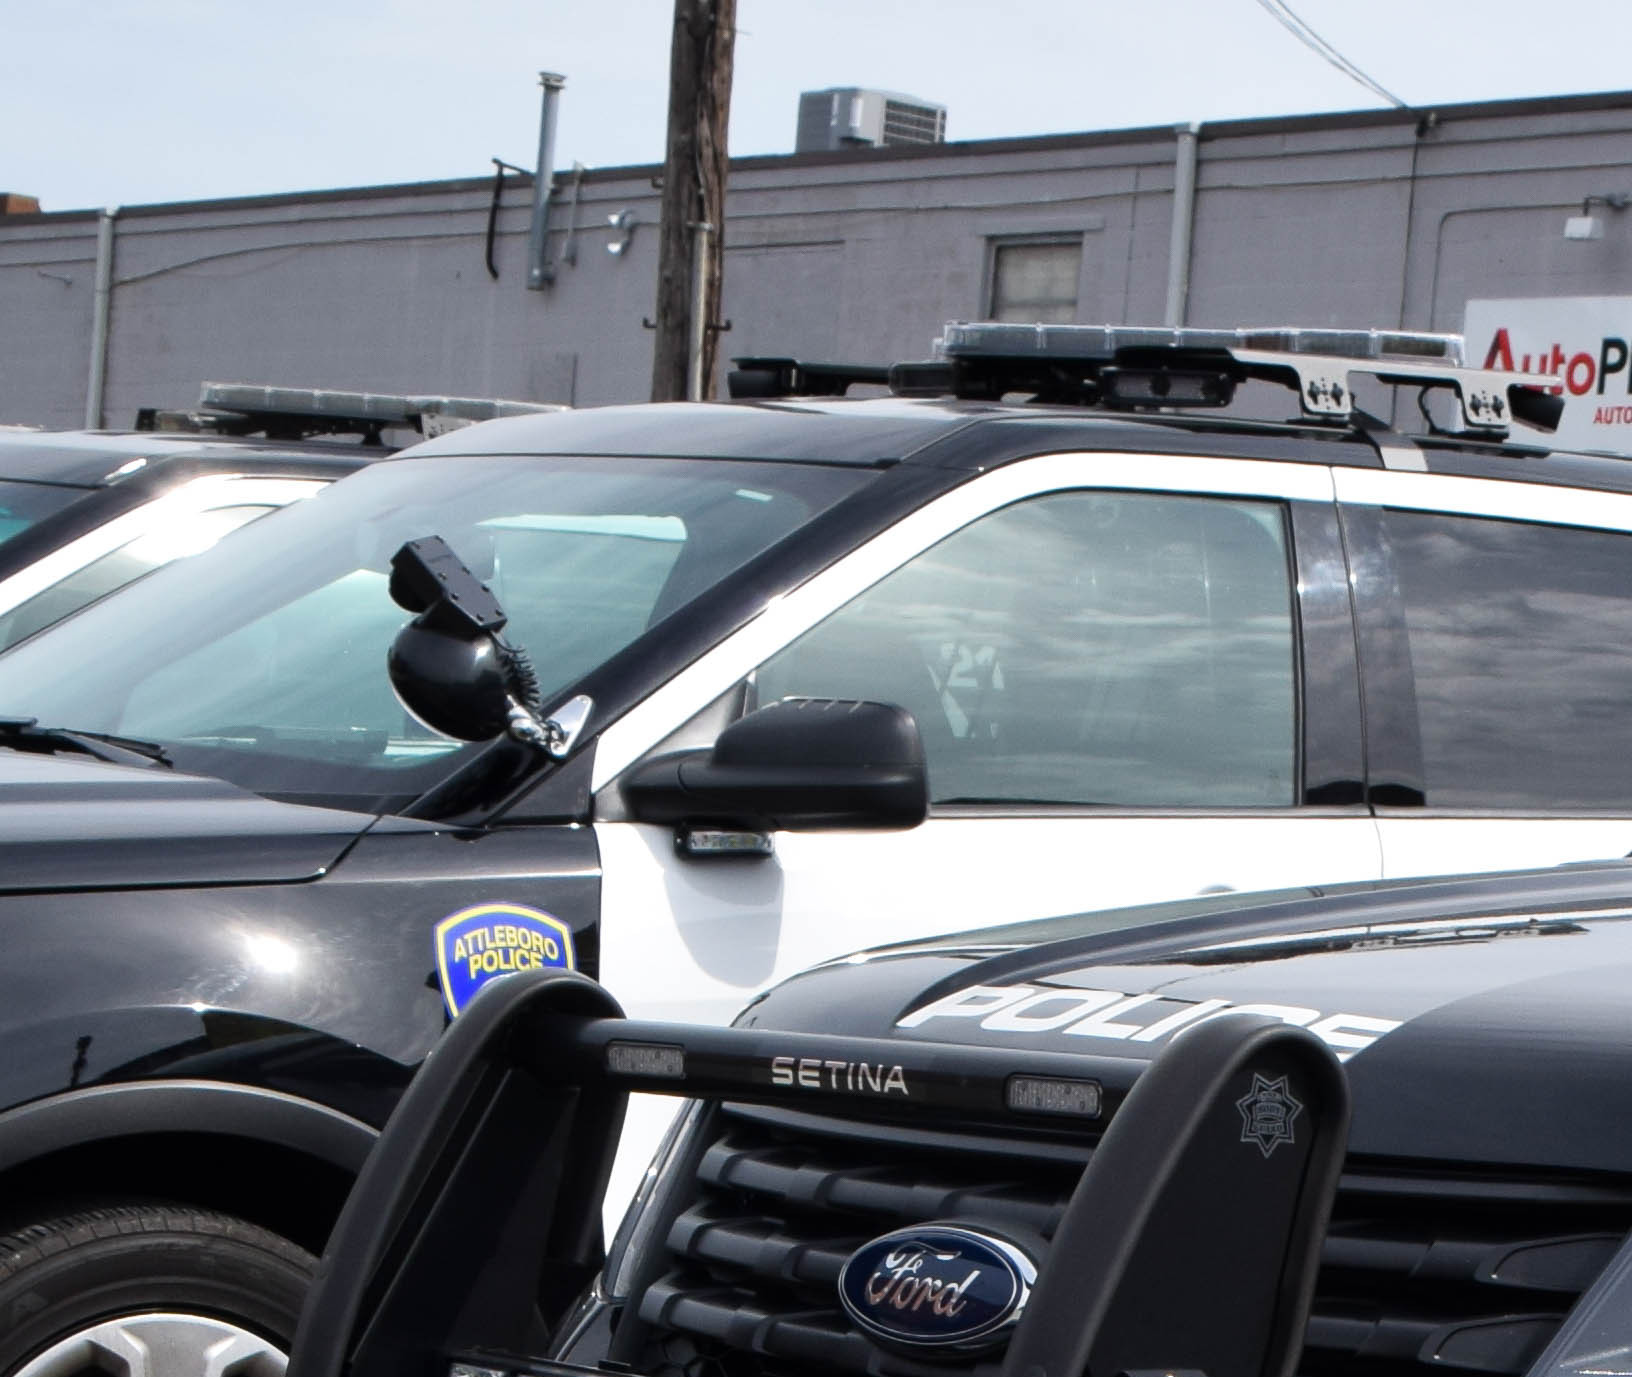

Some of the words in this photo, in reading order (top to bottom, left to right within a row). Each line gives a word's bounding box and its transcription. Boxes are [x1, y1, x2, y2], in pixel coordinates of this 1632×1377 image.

[454, 925, 559, 962] ATTLEBORO
[468, 948, 543, 980] POLICE
[771, 1056, 909, 1096] SETINA
[865, 1240, 982, 1318] Ford
